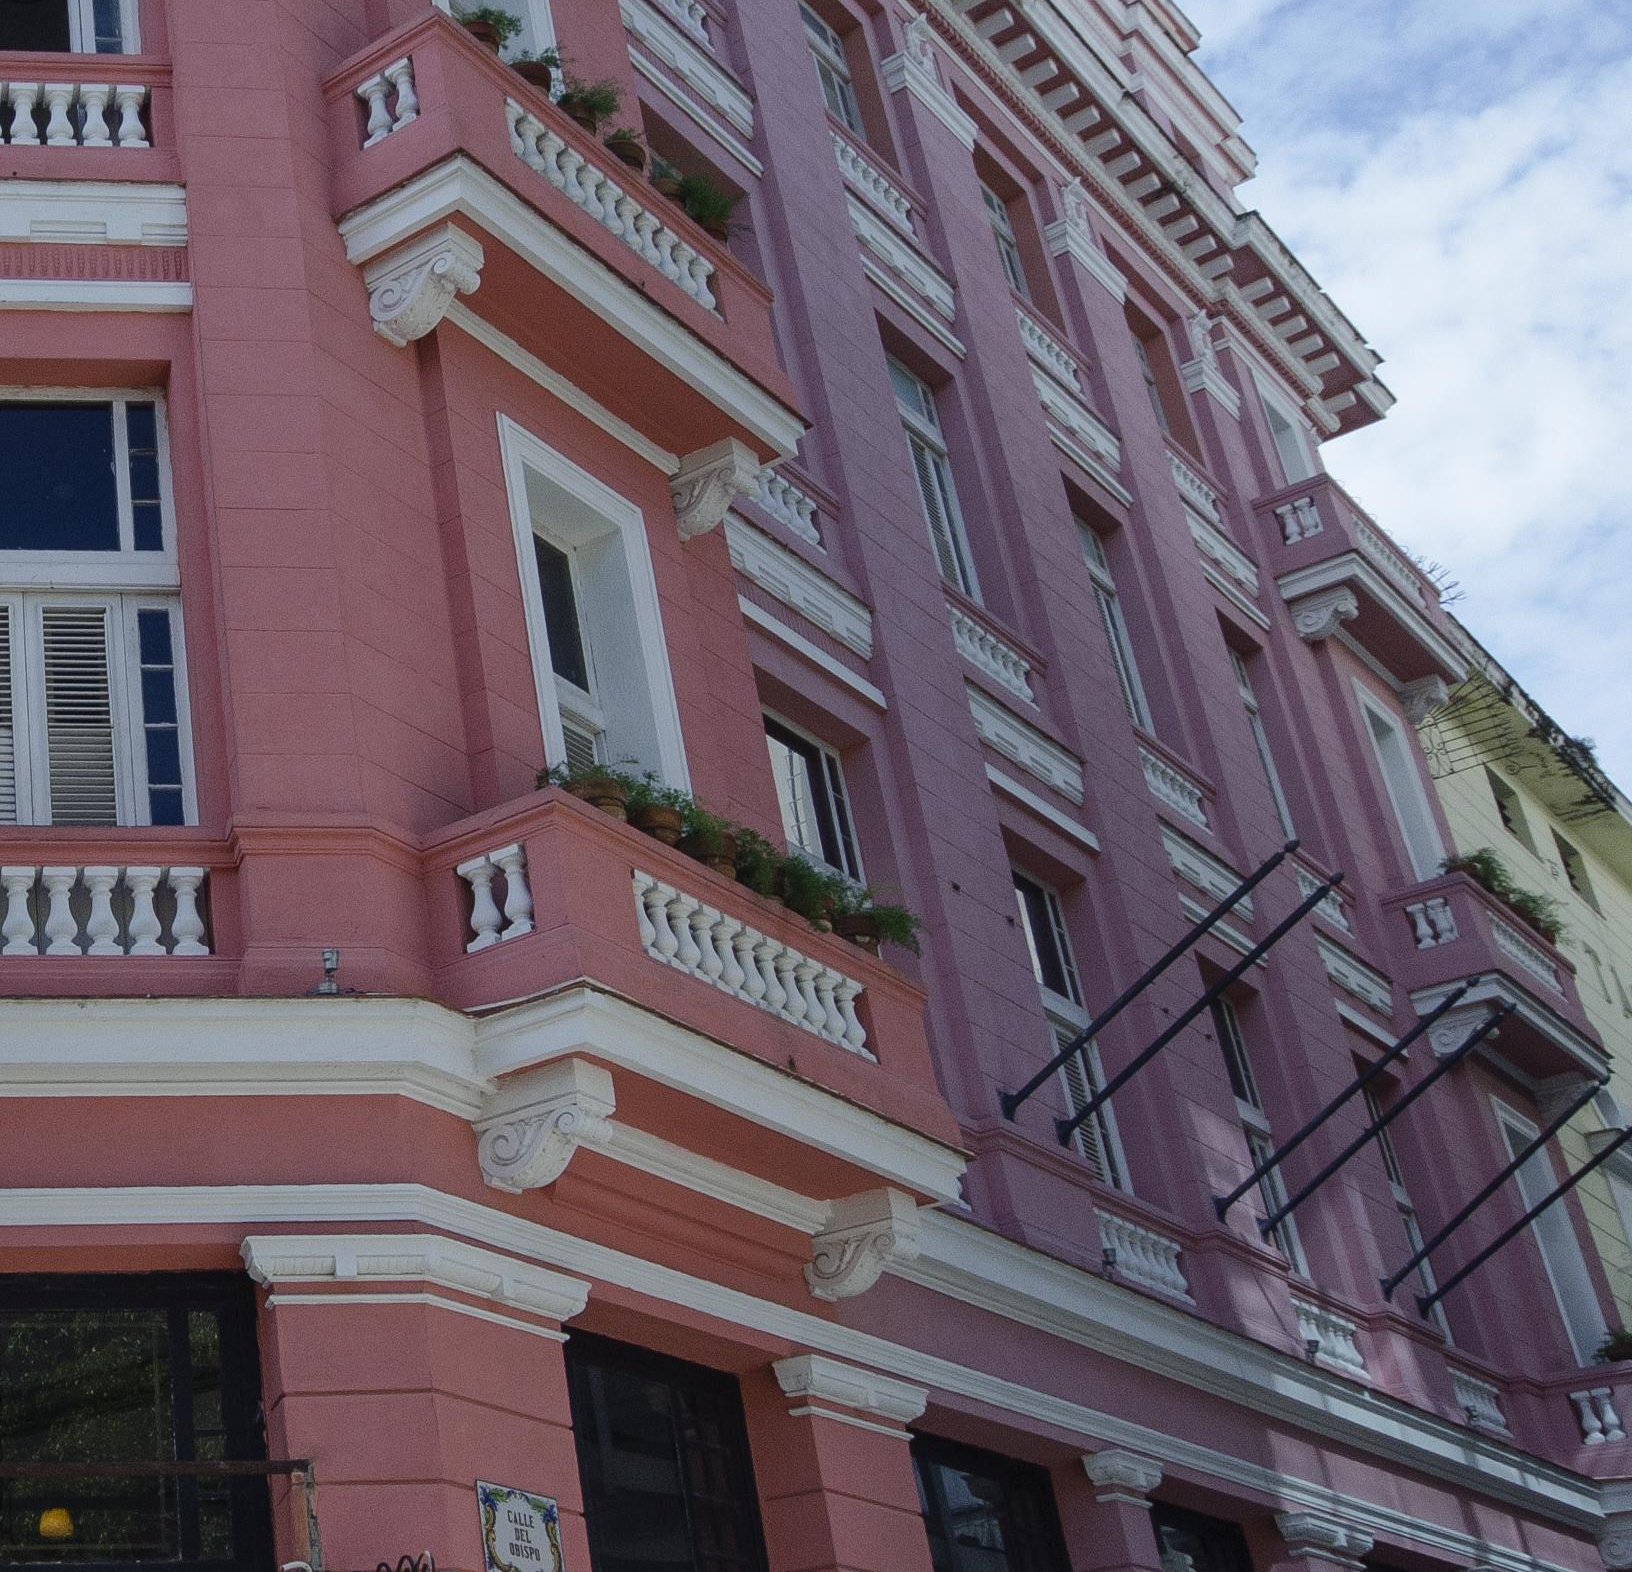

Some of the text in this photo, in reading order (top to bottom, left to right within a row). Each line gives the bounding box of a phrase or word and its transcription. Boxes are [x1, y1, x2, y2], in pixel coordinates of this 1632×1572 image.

[507, 1509, 535, 1529] CALLE
[514, 1527, 532, 1543] DEL
[509, 1542, 541, 1561] OBISPO
